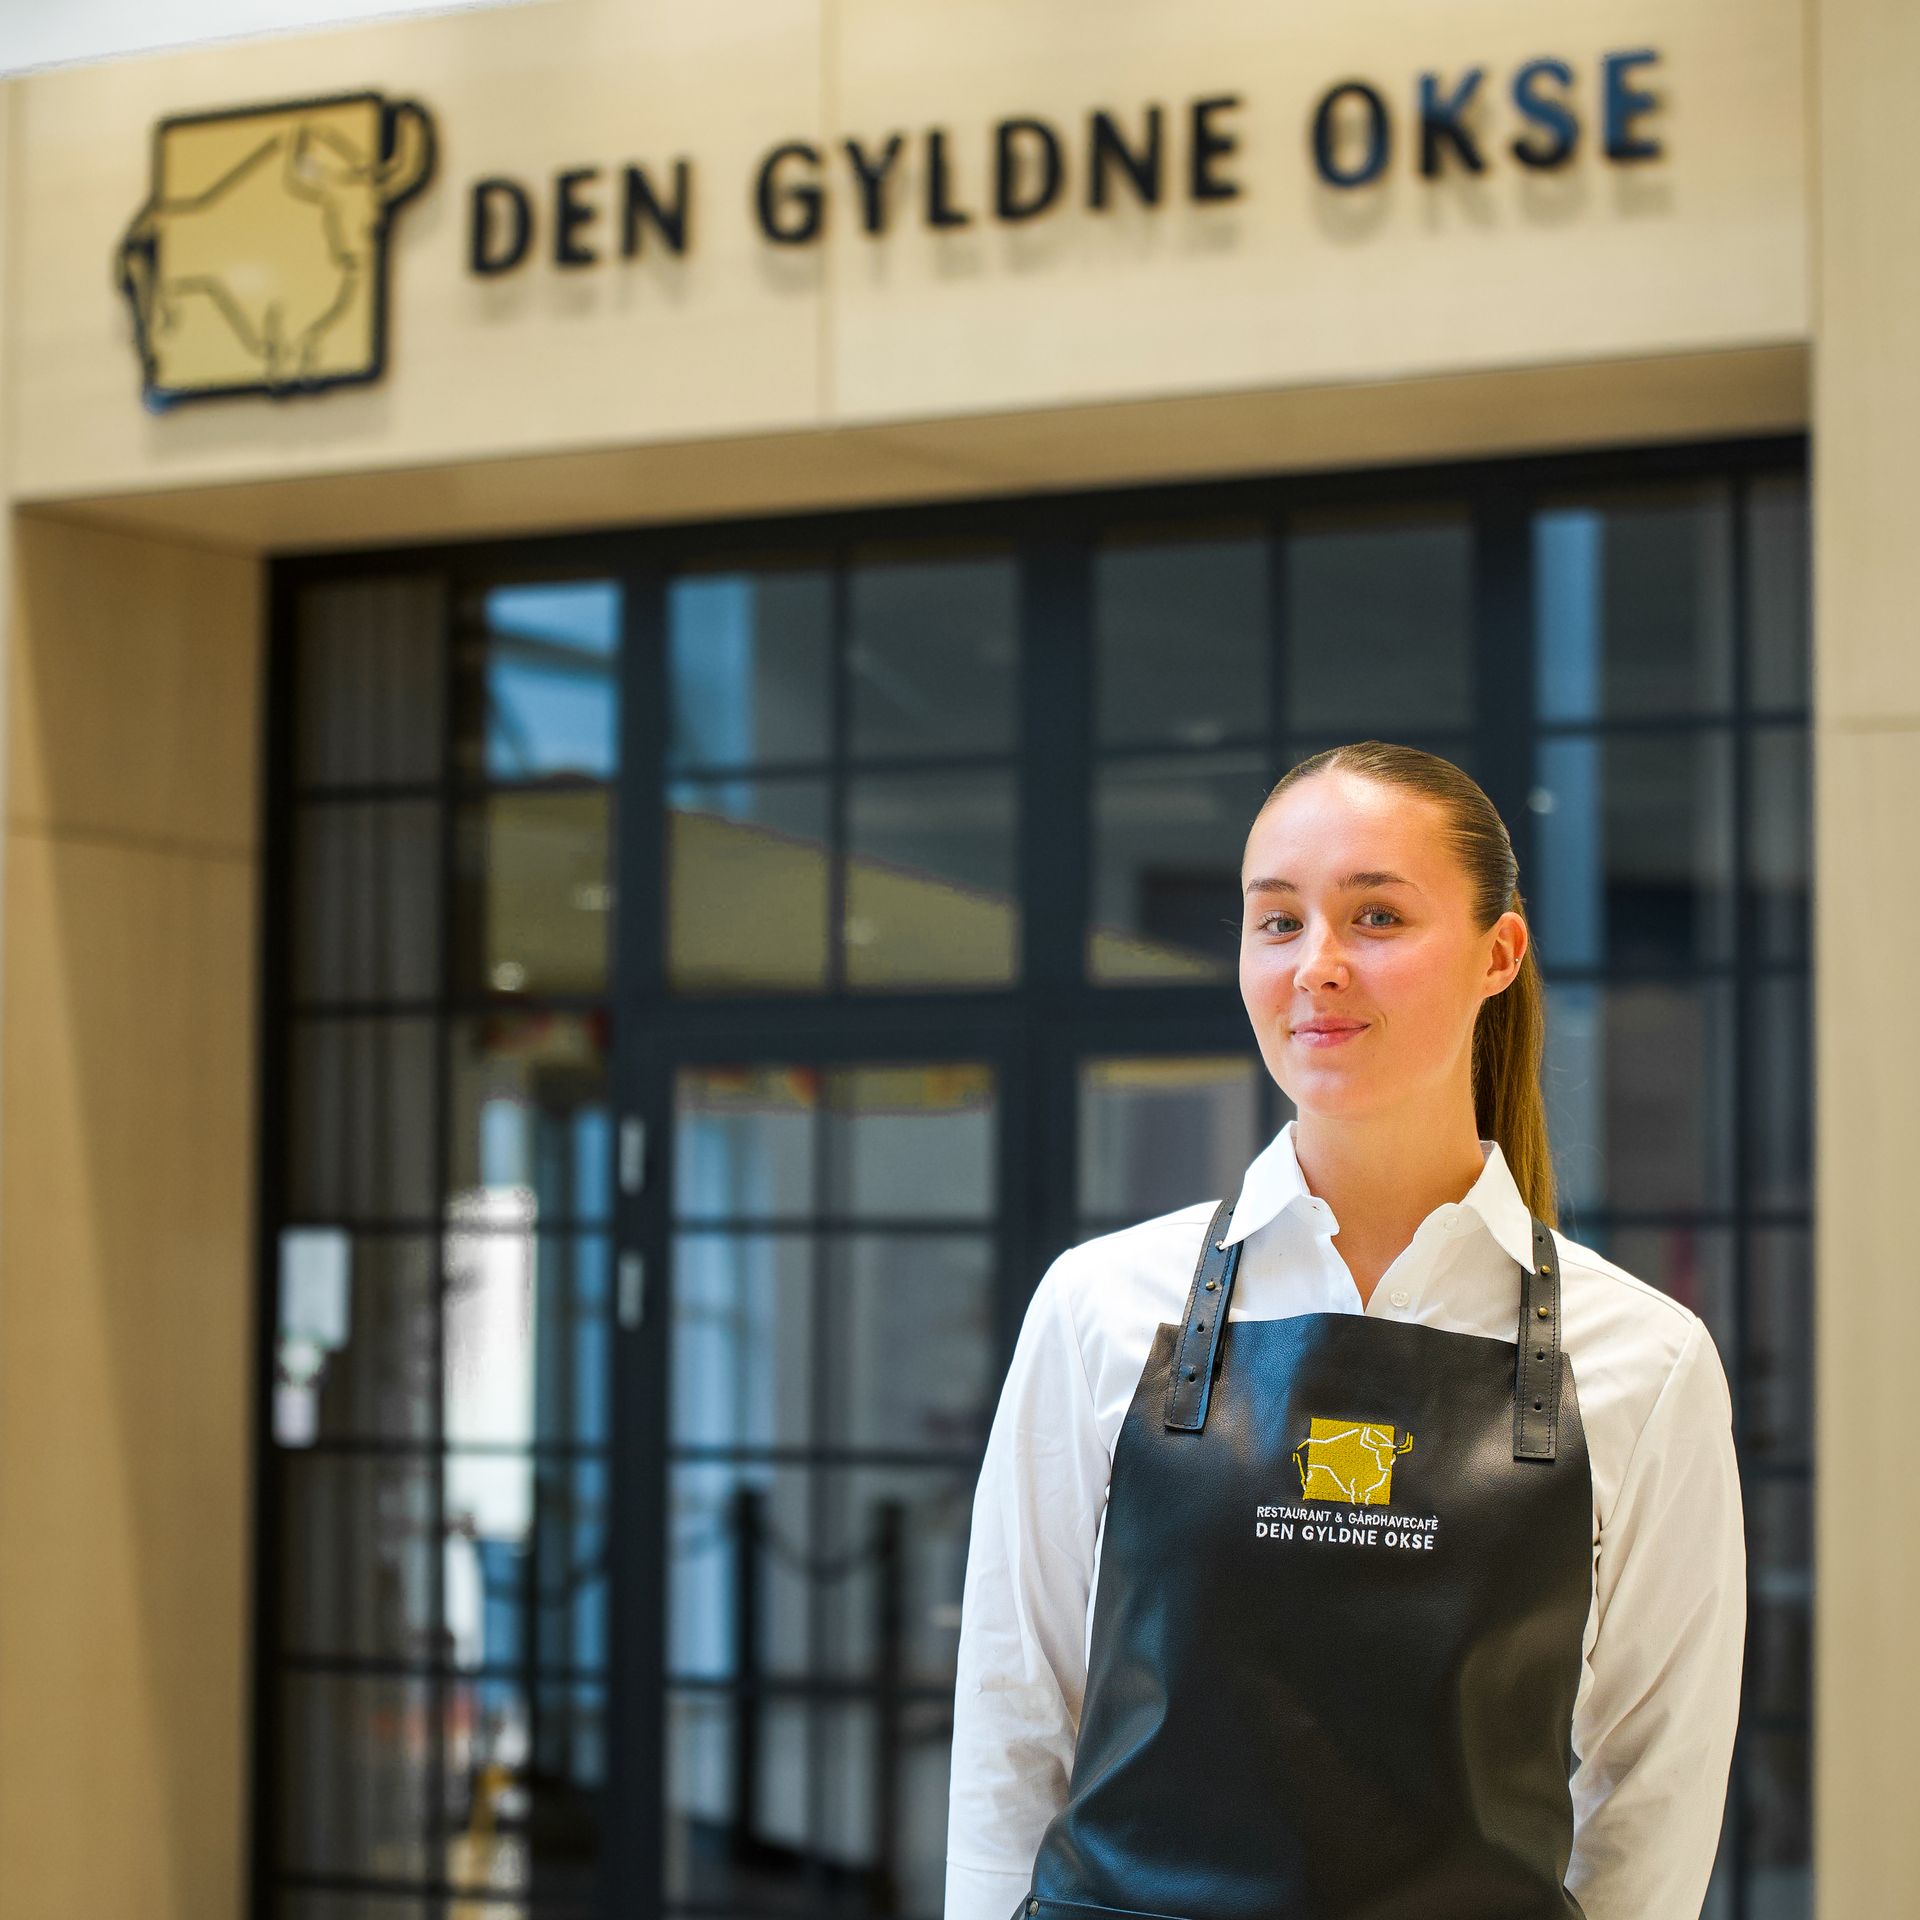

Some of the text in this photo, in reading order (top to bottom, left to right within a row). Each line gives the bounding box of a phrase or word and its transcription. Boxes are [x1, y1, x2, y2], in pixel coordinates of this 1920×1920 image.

[468, 49, 1661, 279] DEN GYLDNE OKSE
[1256, 1506, 1331, 1523] RESTAURANT
[1334, 1512, 1343, 1523] &
[1256, 1522, 1435, 1550] DEN GYLDNE OKSE
